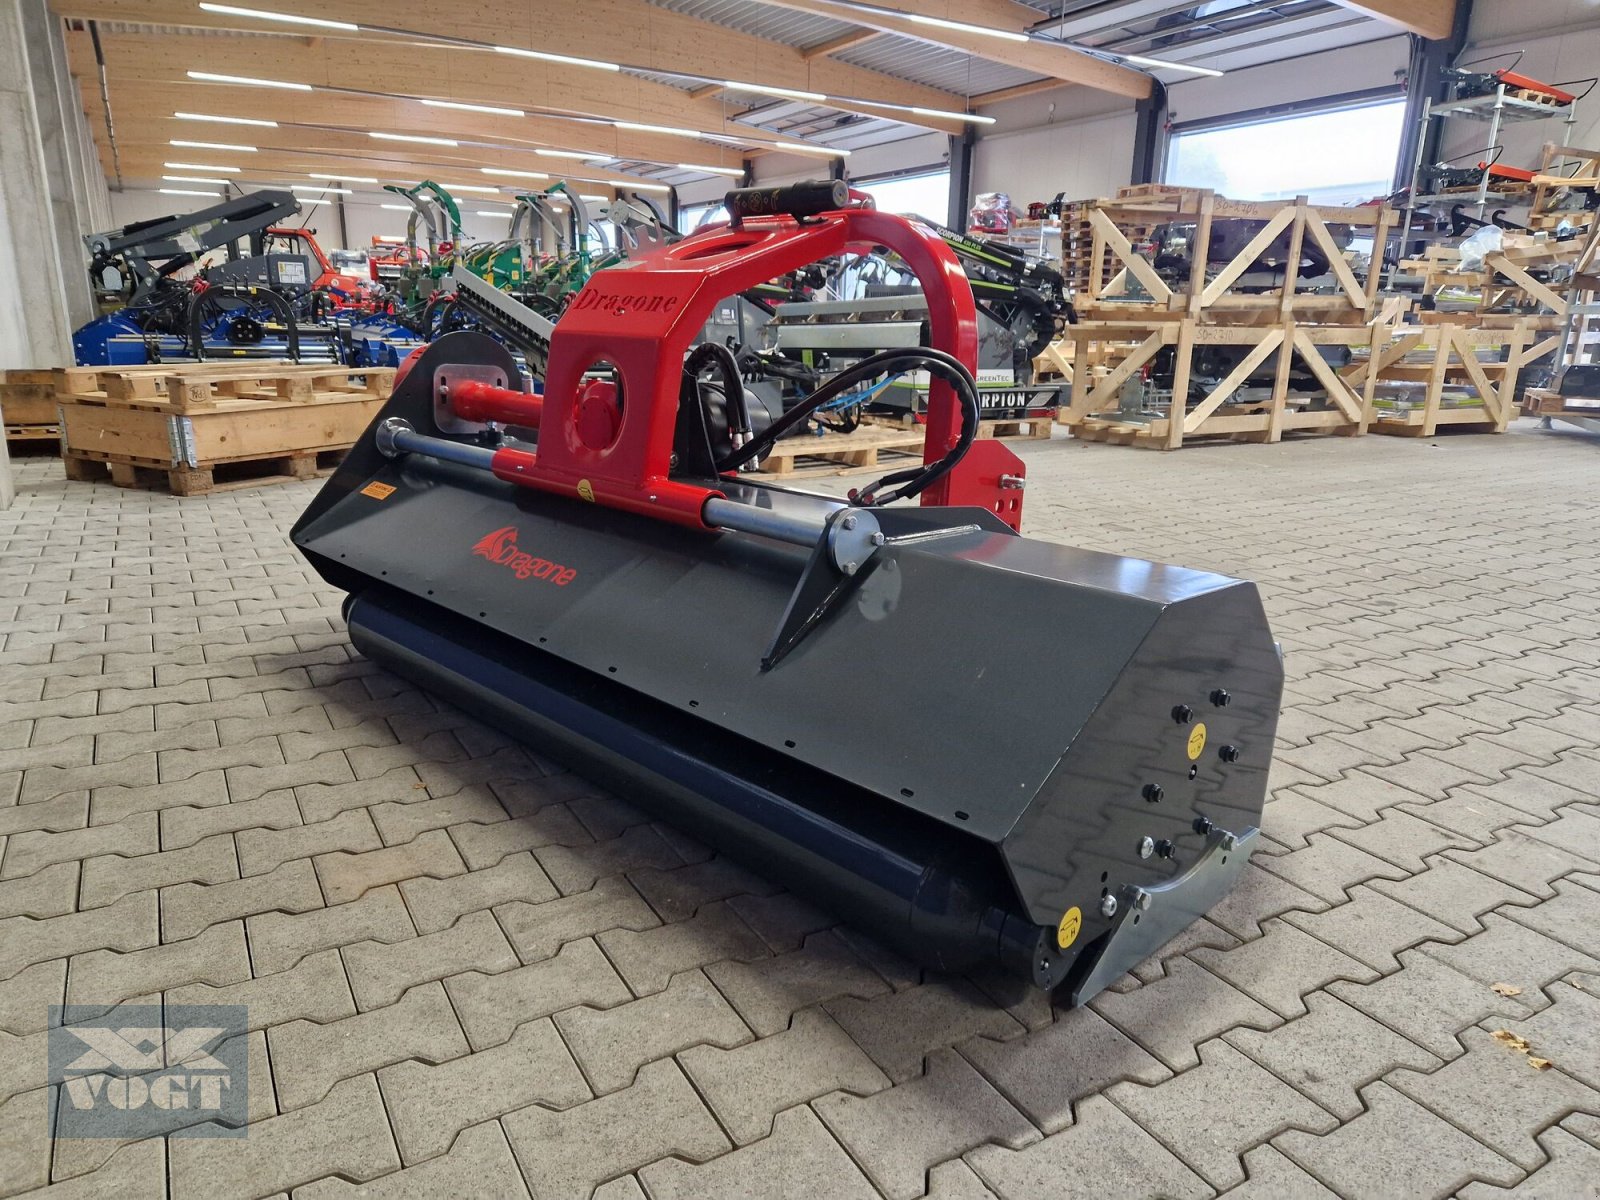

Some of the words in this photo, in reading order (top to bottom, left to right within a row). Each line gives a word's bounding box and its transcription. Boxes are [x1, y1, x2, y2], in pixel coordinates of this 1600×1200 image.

[936, 226, 964, 243] SCORPION
[573, 288, 678, 316] Dragone
[981, 392, 1025, 408] RPION
[490, 545, 577, 586] Dragone
